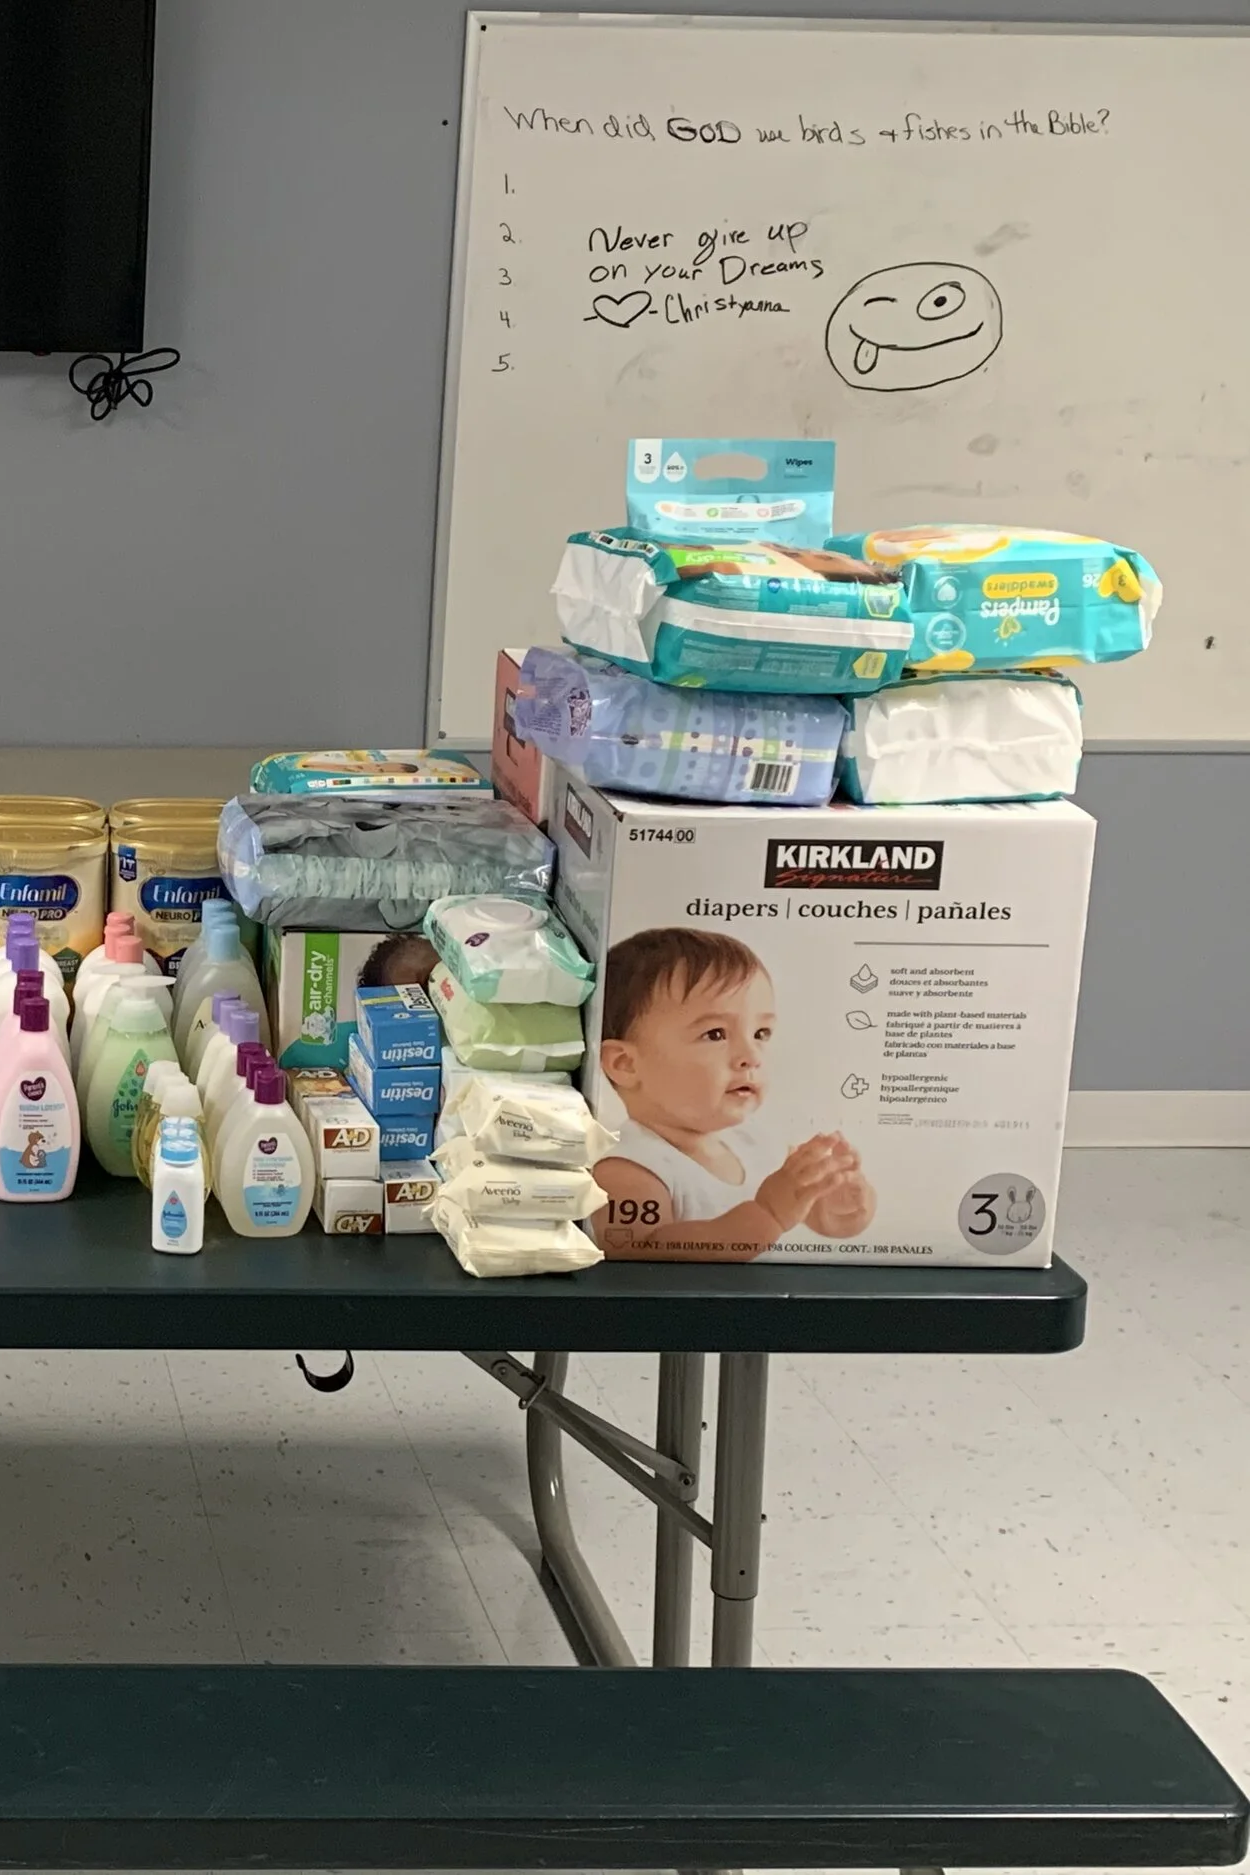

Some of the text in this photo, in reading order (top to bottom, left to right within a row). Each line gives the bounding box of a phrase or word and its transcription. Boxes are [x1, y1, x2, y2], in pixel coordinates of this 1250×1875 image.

[503, 106, 594, 135] When
[603, 114, 655, 141] did
[667, 116, 741, 143] GOD
[798, 114, 866, 146] birds
[902, 112, 971, 141] fishes
[979, 120, 1003, 141] in
[1004, 108, 1044, 135] the
[1048, 108, 1110, 135] Bible?
[588, 225, 675, 253] Never
[767, 221, 808, 253] up
[589, 255, 824, 285] on your Dreams
[643, 453, 653, 465] 3
[785, 457, 813, 468] Wipes
[980, 596, 1061, 627] Pampers
[776, 845, 936, 870] KIRKLAND
[775, 868, 934, 889] Signature
[0, 882, 68, 902] Enfamil
[152, 884, 222, 903] Enfamil
[38, 909, 64, 920] PRO
[155, 911, 192, 921] NEURO
[686, 898, 1012, 923] diapers couches pañales
[890, 967, 975, 976] soft and absorbent
[306, 951, 326, 1011] air-dry
[324, 957, 335, 1005] channels
[889, 978, 921, 986] douces
[933, 978, 989, 987] absorbantes
[922, 990, 974, 998] absorbente
[887, 1010, 911, 1018] made
[913, 1010, 932, 1018] with
[986, 1011, 1027, 1019] materials
[933, 1021, 961, 1030] partir
[962, 1021, 972, 1029] de
[906, 1030, 918, 1038] de
[920, 1030, 953, 1039] plantes
[884, 1040, 925, 1049] fabricado
[944, 1041, 989, 1050] materiales
[996, 1042, 1016, 1050] base
[382, 1046, 435, 1060] Desitin
[883, 1049, 927, 1059] de plantas
[881, 1073, 948, 1083] hypoallergenic
[381, 1087, 434, 1101] Desitin
[494, 1115, 534, 1133] Aveeno
[481, 1184, 522, 1197] Aveeno
[608, 1199, 661, 1226] 198
[968, 1193, 999, 1236] 3
[682, 1241, 725, 1251] DIAPERS
[784, 1243, 832, 1253] COUCHES
[873, 1244, 889, 1254] 198
